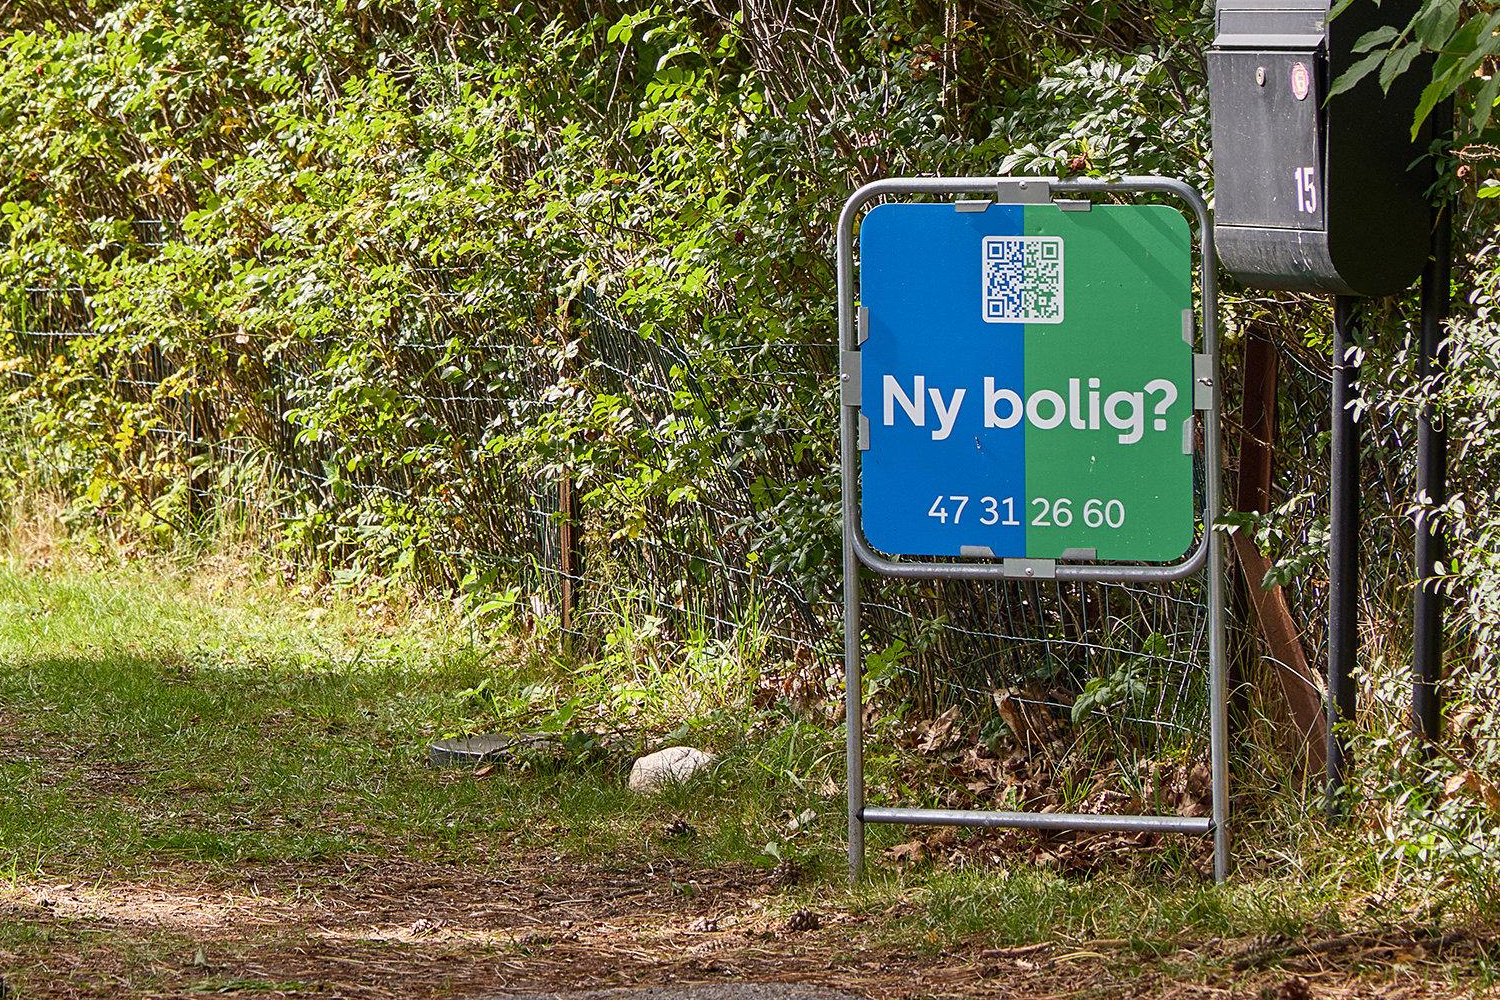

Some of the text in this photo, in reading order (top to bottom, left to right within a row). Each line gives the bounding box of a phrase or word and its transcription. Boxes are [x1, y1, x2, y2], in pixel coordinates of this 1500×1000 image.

[1294, 166, 1317, 214] 15
[883, 374, 1178, 445] Ny bolig?
[928, 495, 1125, 529] 47 31 26 60
